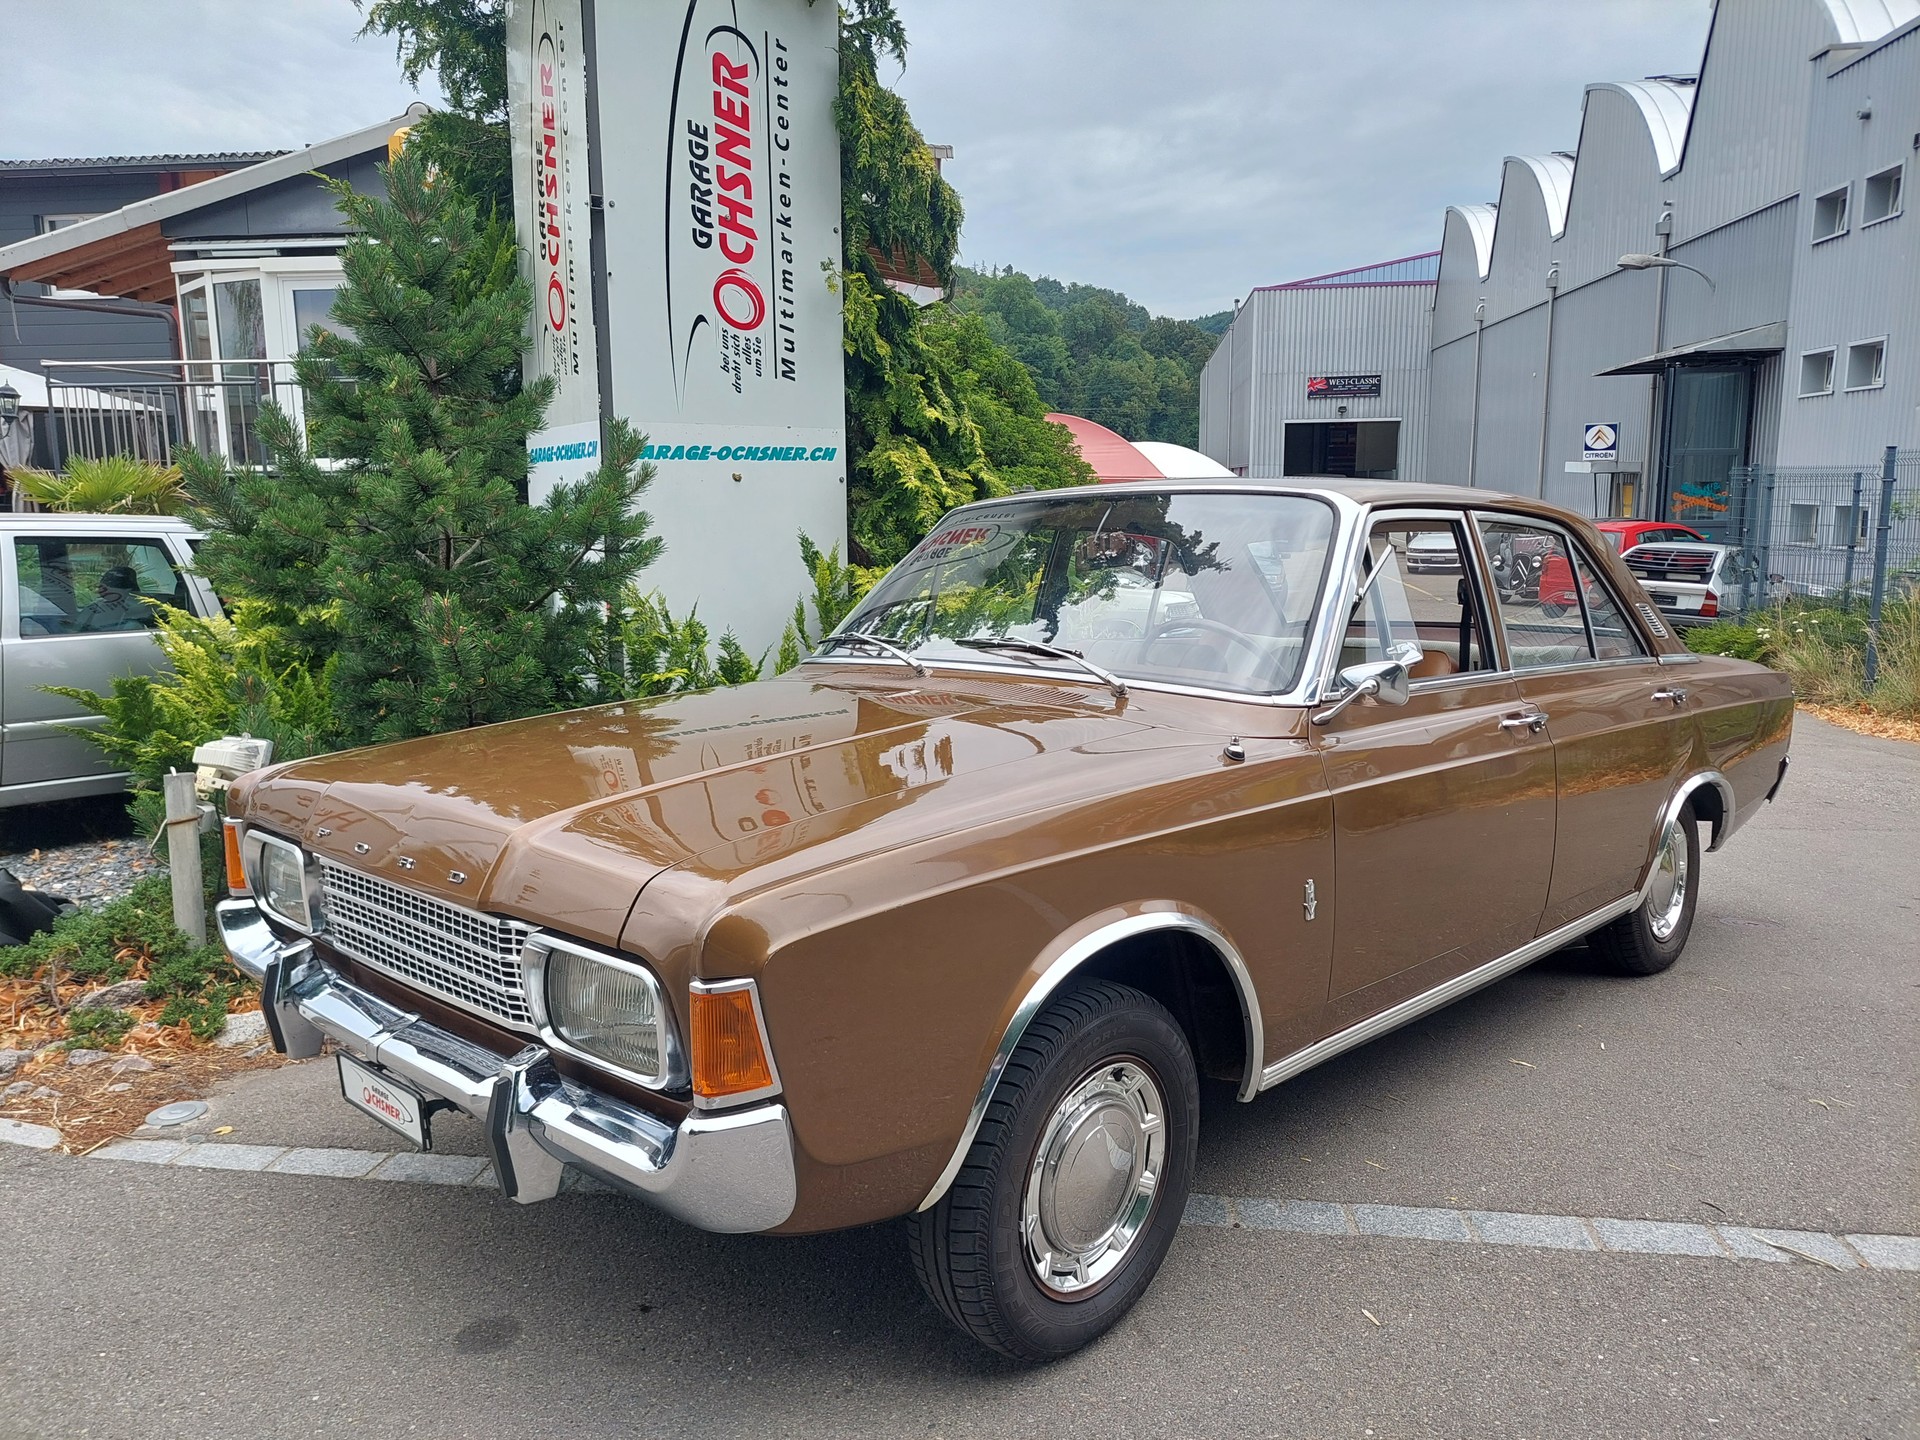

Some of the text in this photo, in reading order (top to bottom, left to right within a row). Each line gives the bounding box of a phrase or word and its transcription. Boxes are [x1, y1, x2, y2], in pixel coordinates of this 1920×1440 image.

[535, 140, 547, 261] GARAGE
[687, 119, 714, 249] GARAGE
[712, 51, 766, 331] OCHSNER
[773, 37, 797, 382] Multimarken-Center
[720, 327, 730, 373] bei uns
[730, 334, 742, 394] dreht sich
[742, 336, 752, 365] alles
[752, 337, 762, 377] um Sie
[1328, 377, 1380, 387] WEST-CLASSIC
[638, 444, 838, 462] ARAGE-OCHSNER.CH
[316, 827, 468, 885] FORD
[363, 1087, 402, 1121] OCHSNER
[371, 1085, 390, 1102] GARAGE
